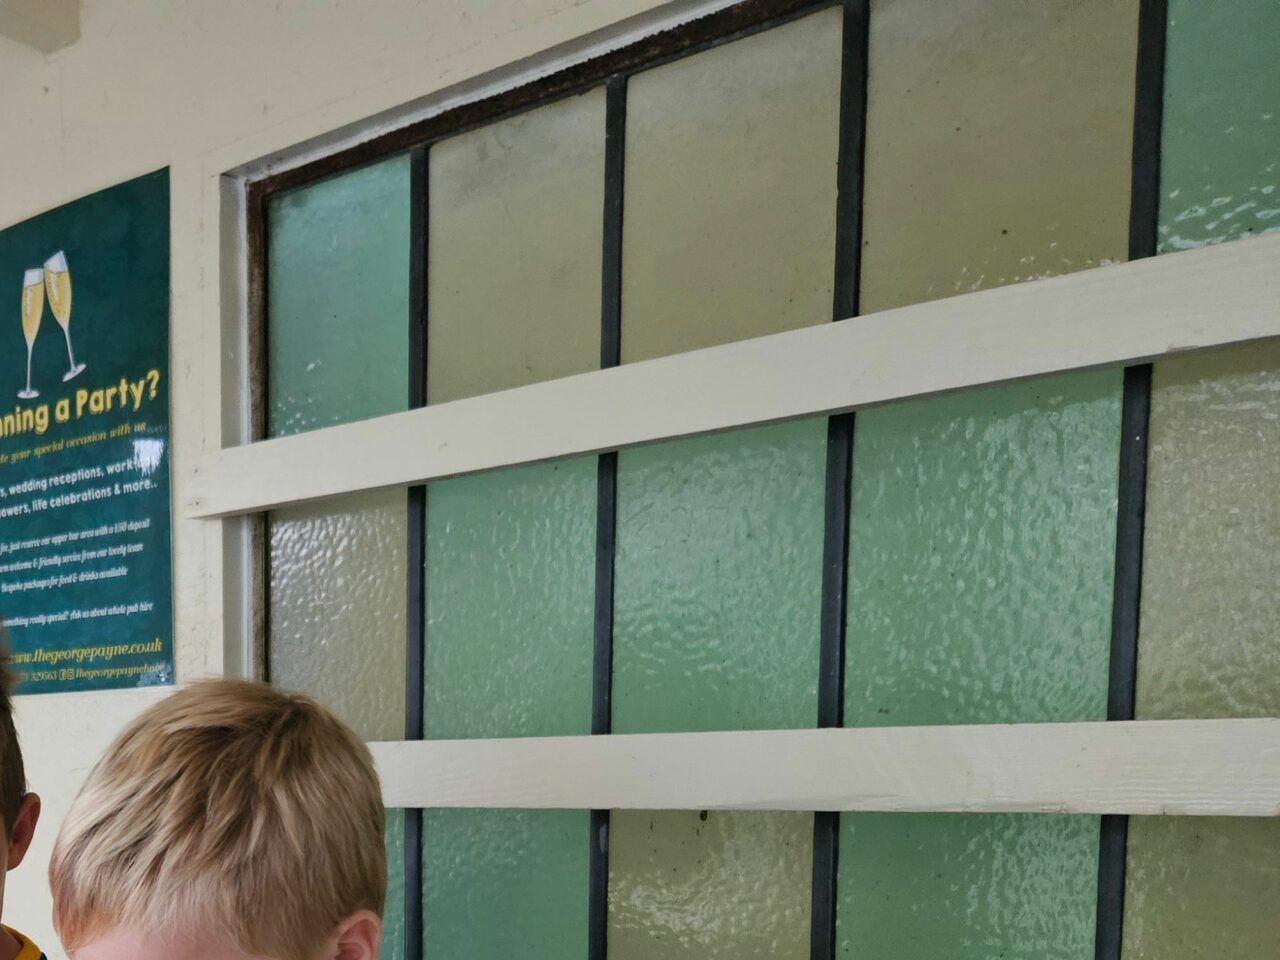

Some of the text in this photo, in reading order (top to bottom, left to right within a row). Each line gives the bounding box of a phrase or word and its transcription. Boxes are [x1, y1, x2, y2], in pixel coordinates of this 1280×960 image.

[55, 399, 70, 423] a
[76, 370, 160, 419] Party?
[11, 450, 31, 464] your
[33, 439, 64, 459] special
[66, 431, 107, 449] occasion
[109, 423, 131, 438] with
[8, 478, 48, 495] wedding
[49, 465, 105, 487] receptions,
[106, 457, 134, 475] work
[32, 497, 48, 512] life
[50, 484, 111, 508] celebrations
[114, 482, 121, 495] &
[68, 530, 78, 540] bar
[127, 517, 150, 532] deposit
[108, 544, 126, 558] lovely
[127, 542, 143, 552] team
[78, 570, 98, 582] drinks
[99, 565, 127, 579] available
[126, 602, 138, 615] pub
[139, 600, 153, 611] hire
[9, 638, 162, 666] ww.thegeorgepayne.co.uk
